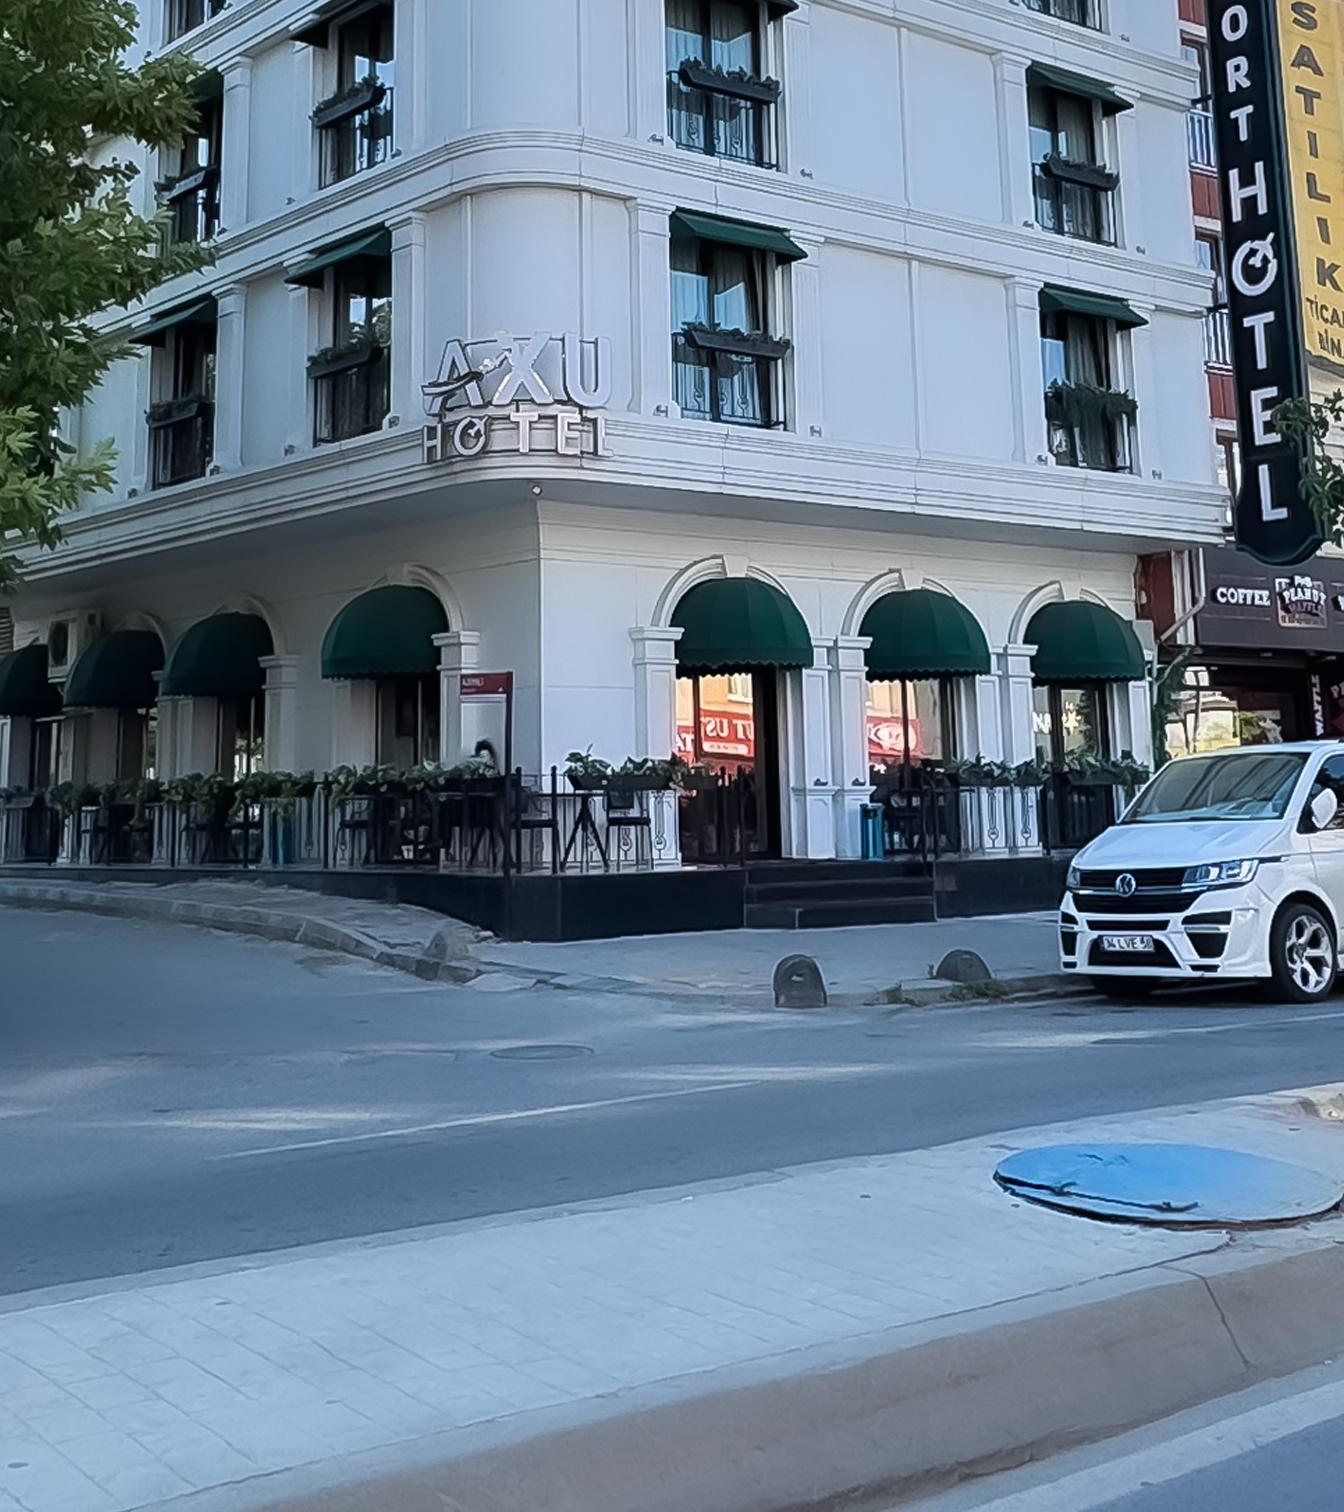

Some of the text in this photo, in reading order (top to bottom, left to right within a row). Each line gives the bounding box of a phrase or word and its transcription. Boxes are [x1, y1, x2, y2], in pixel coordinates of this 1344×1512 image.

[1290, 0, 1344, 292] SATILIK
[421, 331, 612, 417] AXU
[1228, 160, 1288, 523] HOTEL
[423, 412, 615, 464] HOTEL
[1216, 587, 1271, 606] COFFEE
[1282, 587, 1327, 606] PEANUT
